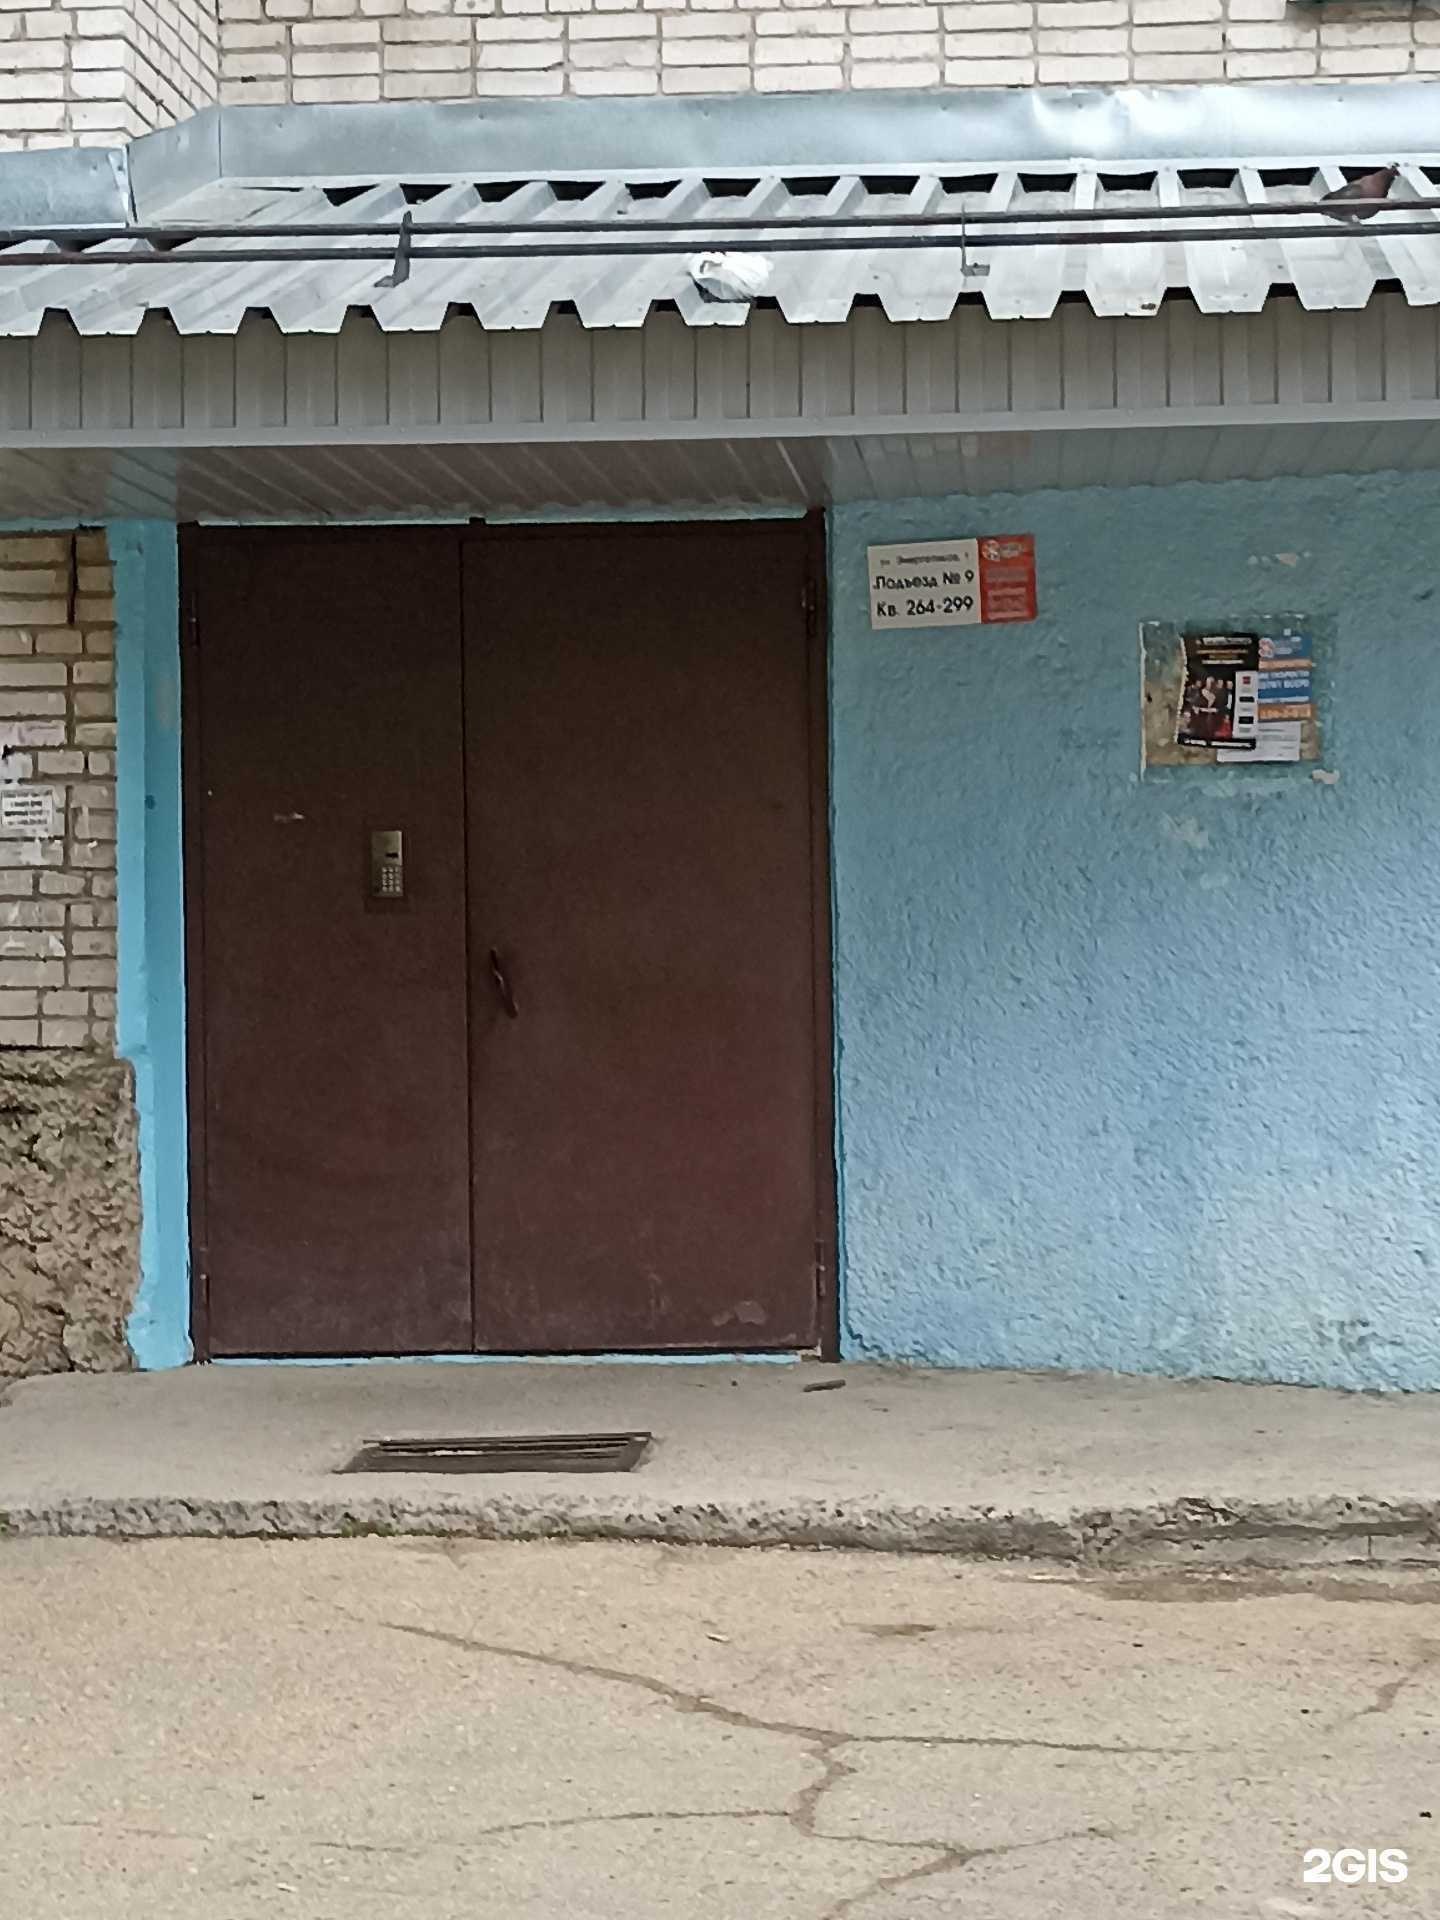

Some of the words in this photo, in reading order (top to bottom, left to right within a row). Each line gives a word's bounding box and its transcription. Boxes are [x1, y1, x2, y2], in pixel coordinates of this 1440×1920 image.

[873, 575, 938, 590] Подъезд
[942, 571, 961, 585] №
[964, 569, 975, 583] 9
[906, 595, 975, 616] 264-299
